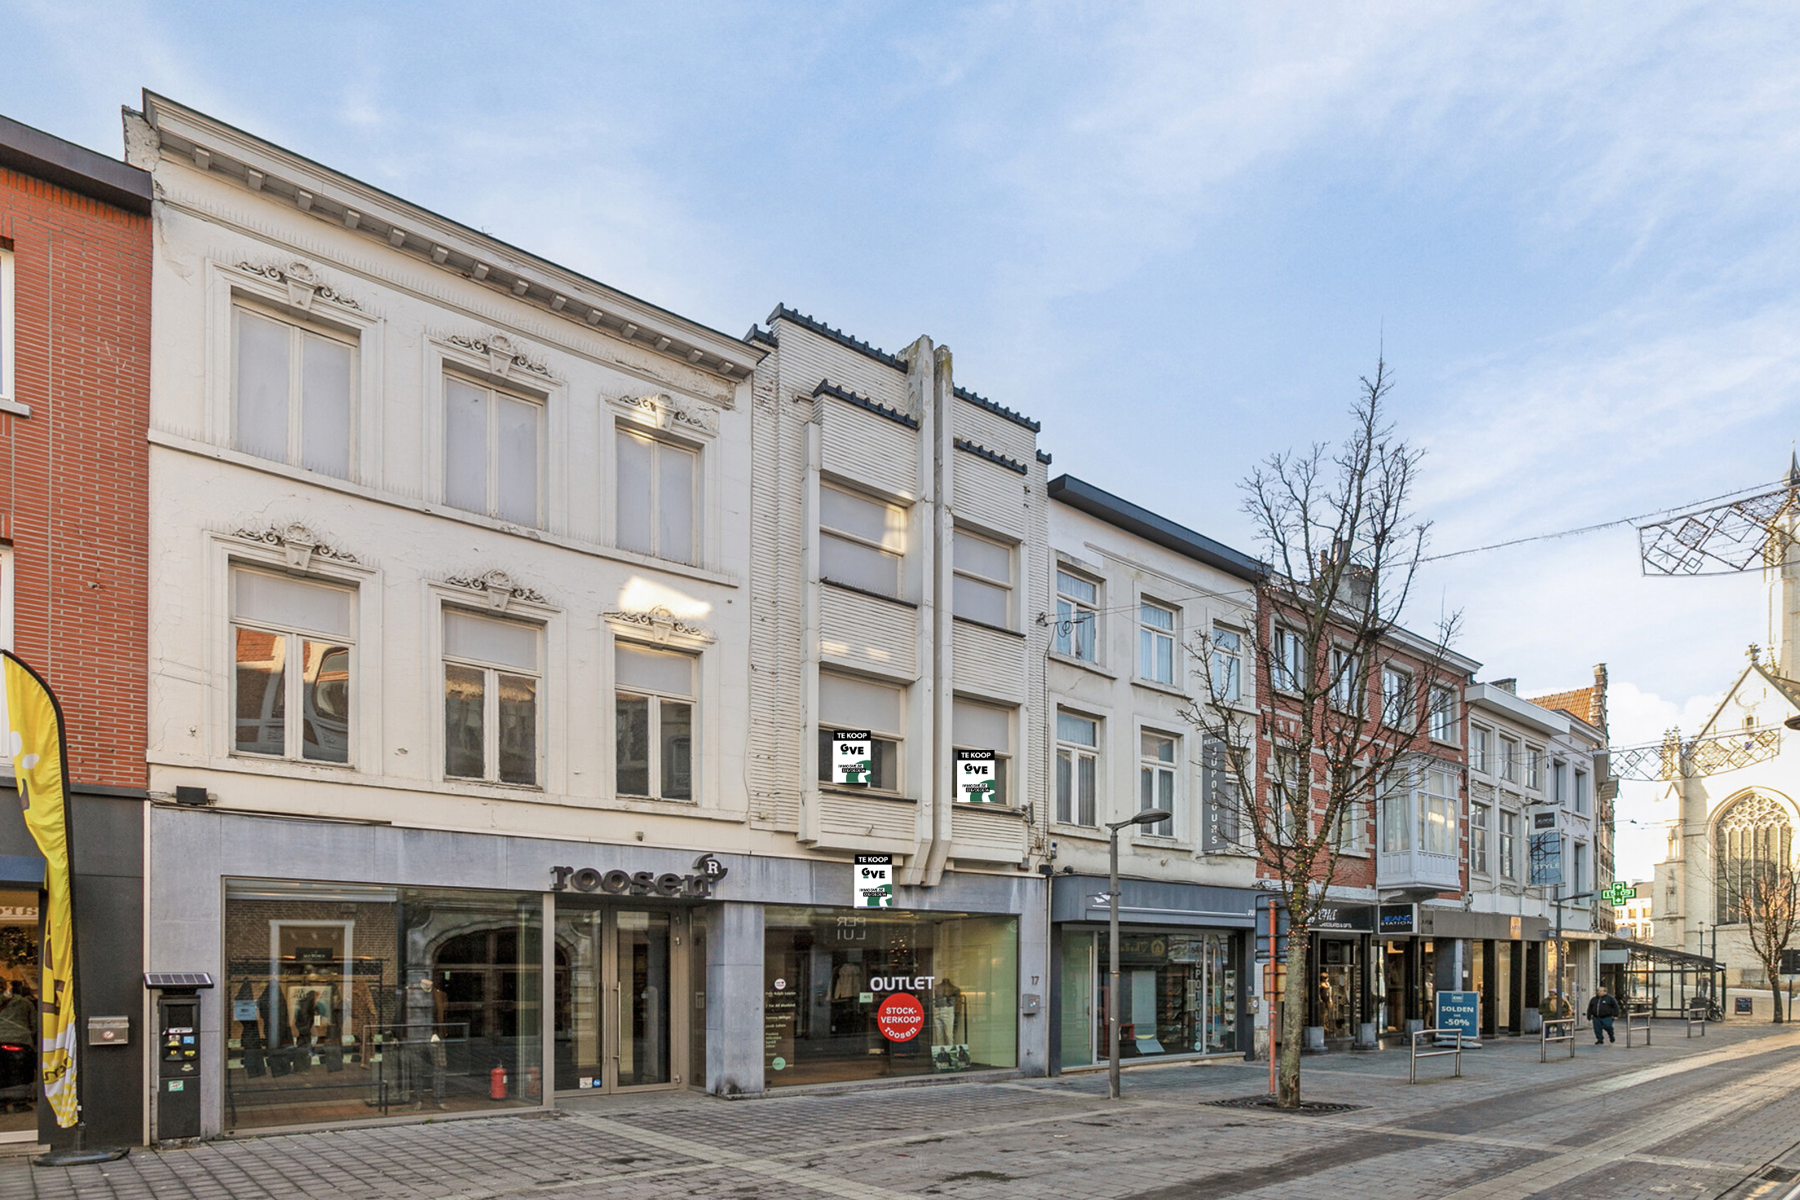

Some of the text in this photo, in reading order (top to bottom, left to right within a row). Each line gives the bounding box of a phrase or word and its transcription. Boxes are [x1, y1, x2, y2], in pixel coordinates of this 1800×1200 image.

[840, 743, 865, 755] GVE
[964, 763, 988, 774] GVE
[706, 861, 718, 874] R
[1534, 863, 1560, 871] STYLE
[861, 867, 886, 879] GVE
[549, 866, 712, 898] roosen
[1380, 914, 1412, 922] JEANS
[870, 976, 935, 991] OUTLET
[1031, 975, 1040, 986] 17
[880, 1016, 921, 1024] VERKOOP
[1444, 1018, 1470, 1026] -50%
[884, 1026, 918, 1039] roosen
